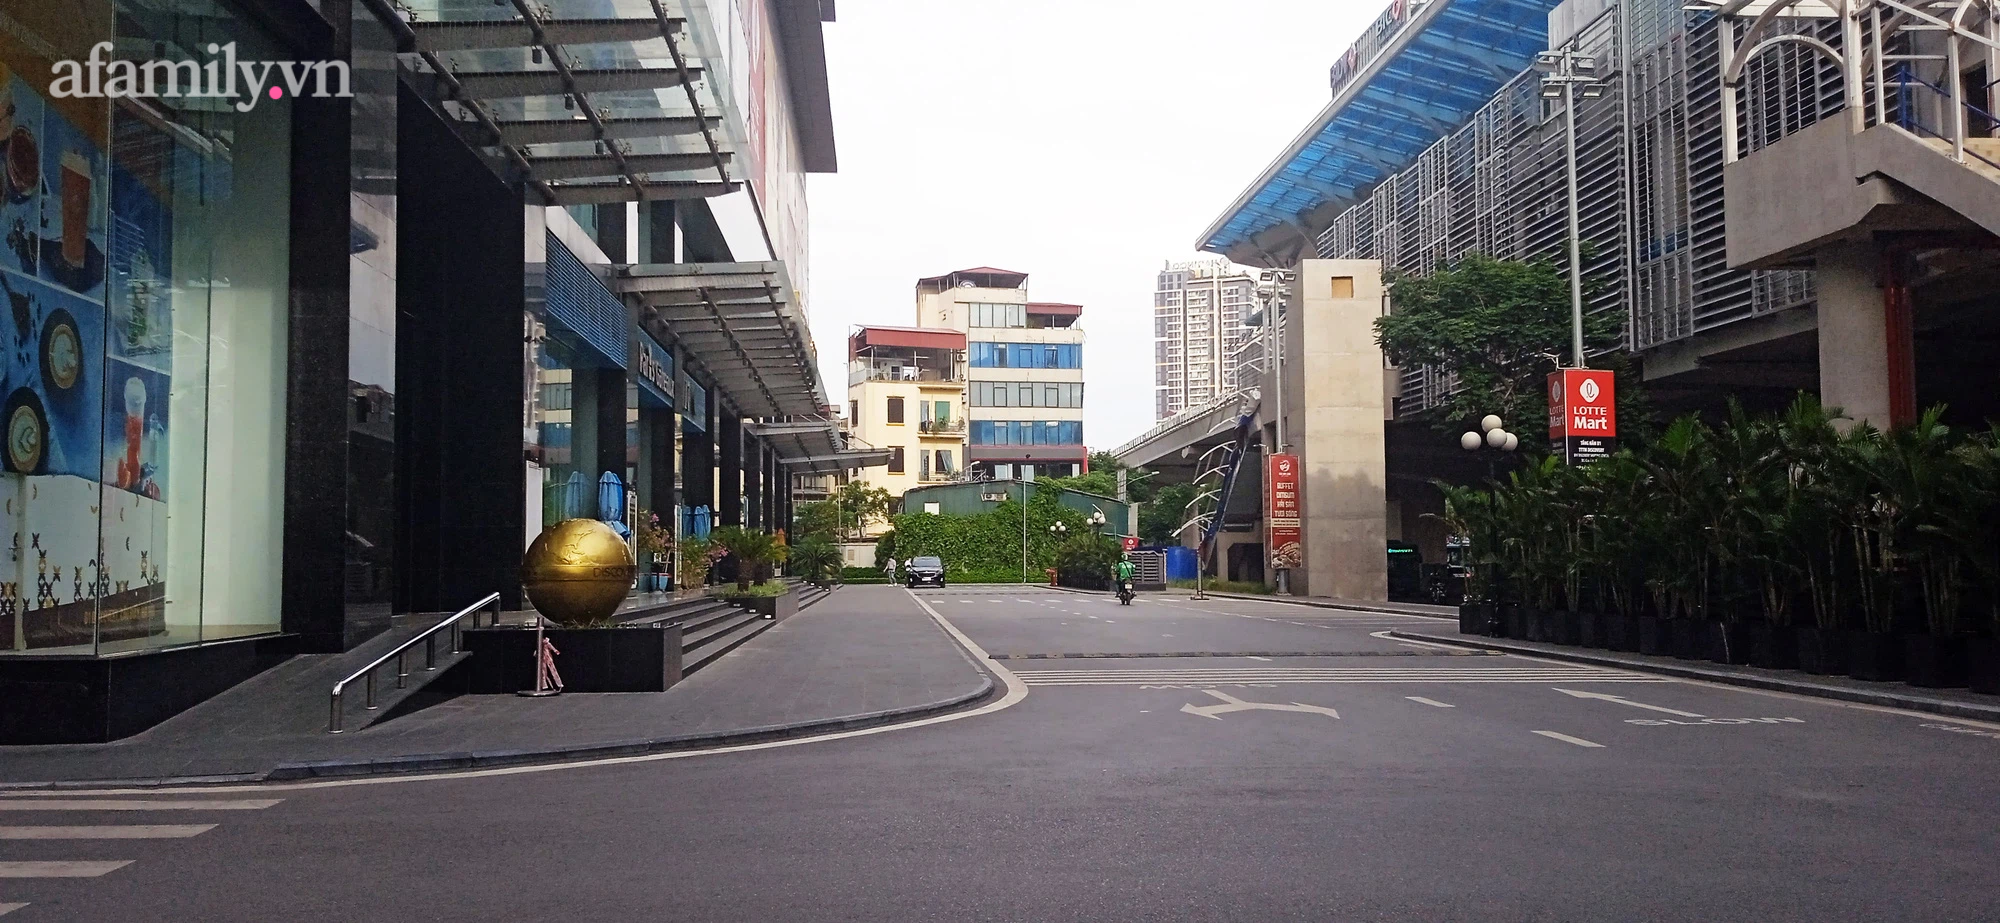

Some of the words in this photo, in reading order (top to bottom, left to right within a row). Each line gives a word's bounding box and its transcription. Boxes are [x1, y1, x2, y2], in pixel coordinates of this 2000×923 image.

[1375, 6, 1393, 37] BIC
[1549, 405, 1564, 415] LOTTE
[1574, 406, 1607, 415] LOTTE
[1550, 415, 1565, 428] Mart
[1574, 416, 1607, 430] Mart
[1624, 717, 1806, 726] SLOW
